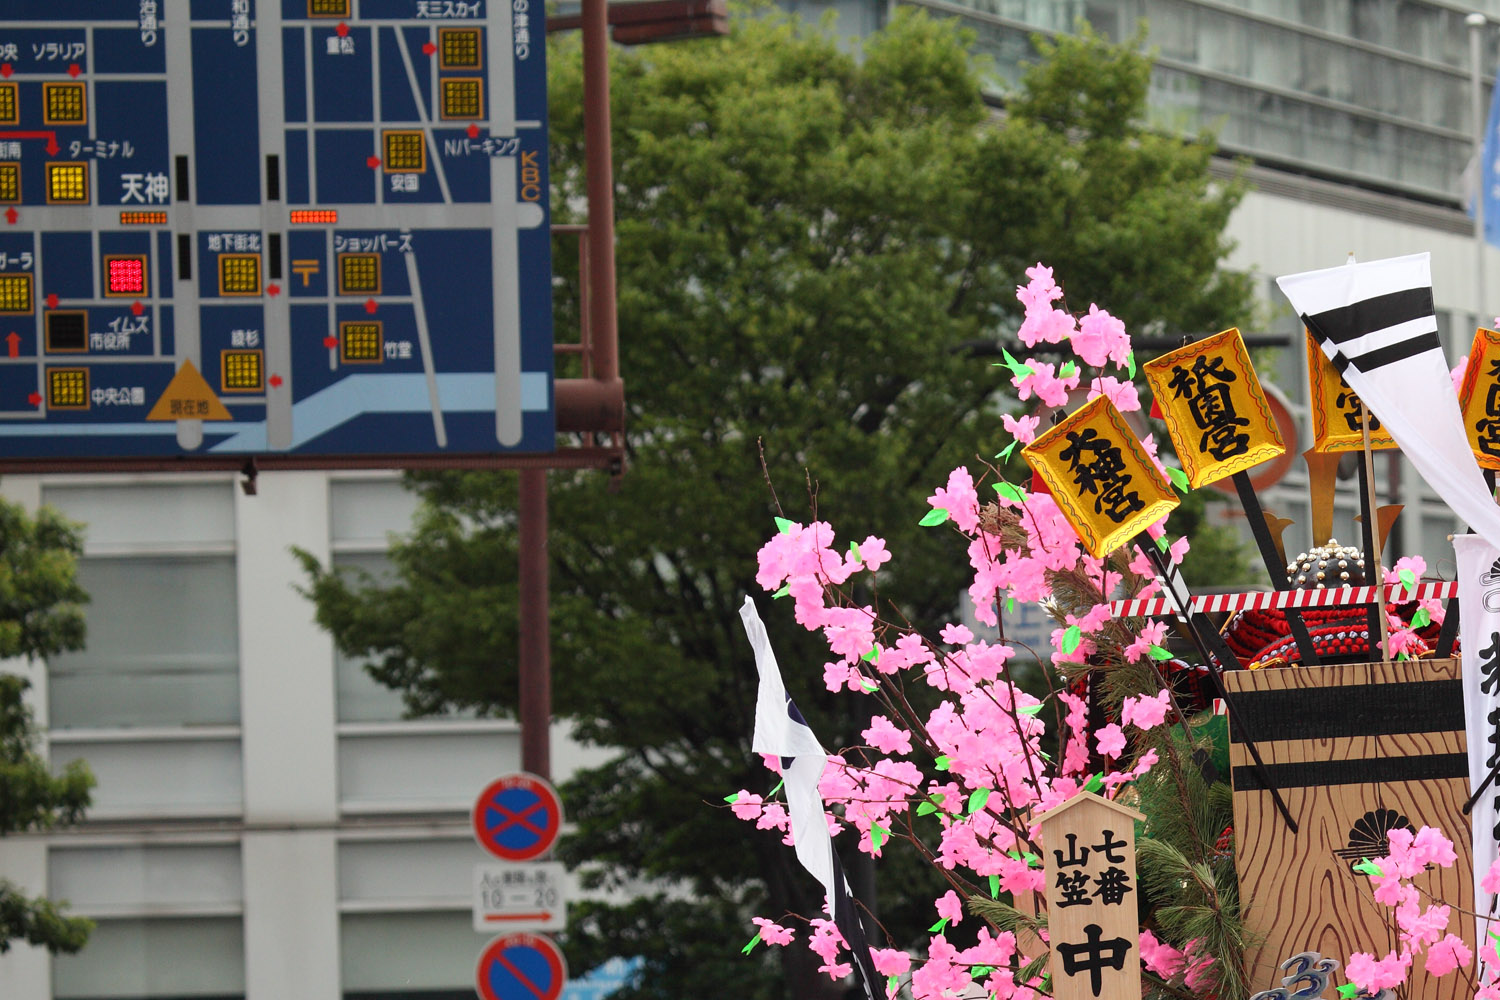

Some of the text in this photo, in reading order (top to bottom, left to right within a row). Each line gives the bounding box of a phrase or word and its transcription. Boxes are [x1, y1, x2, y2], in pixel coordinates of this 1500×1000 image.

[416, 1, 481, 18] 天三スカイ
[32, 43, 85, 60] ソラリア
[326, 36, 355, 55] 重松
[69, 141, 134, 158] ターミナル
[391, 173, 419, 192] 安国
[521, 151, 540, 200] KBC
[121, 172, 169, 203] 天神
[208, 234, 260, 251] 地下街北
[90, 333, 130, 350] 市役所
[92, 387, 145, 406] 中央公園
[170, 399, 209, 415] 現在地
[1060, 428, 1145, 523] 大神宮
[1053, 833, 1093, 908] 山笠
[1091, 829, 1133, 905] 七番
